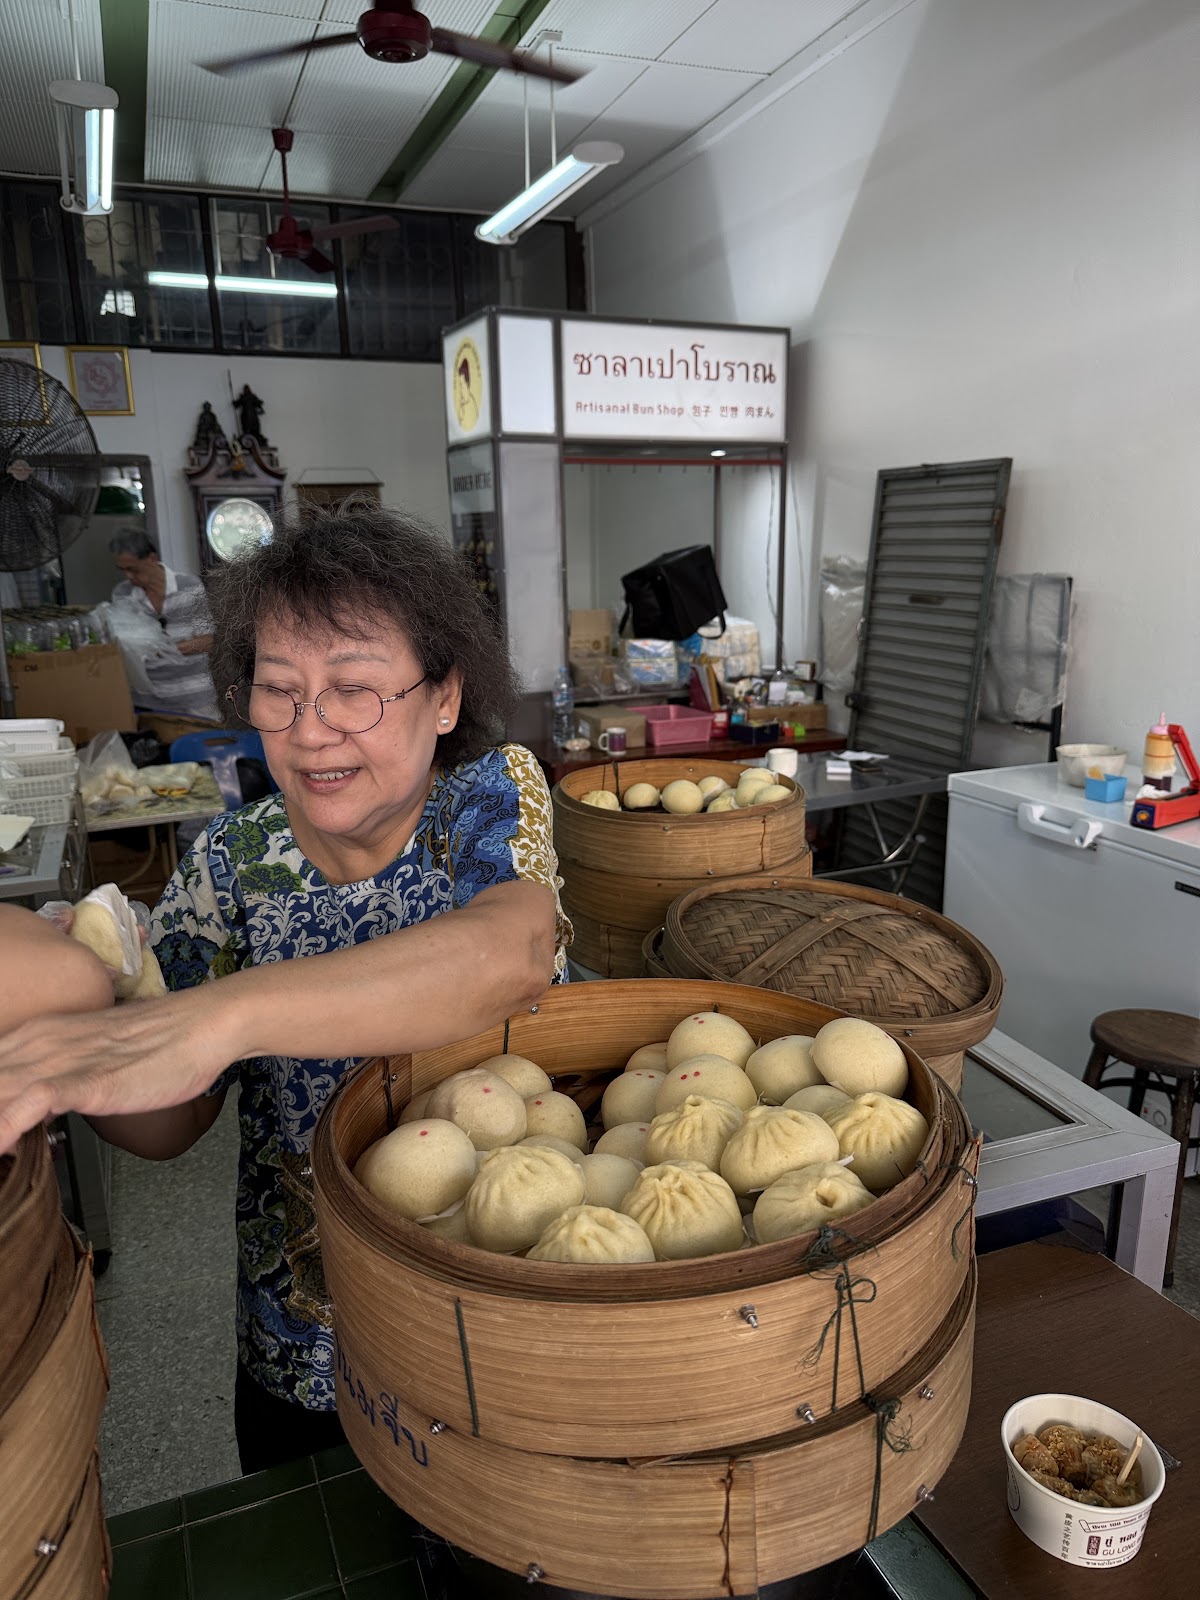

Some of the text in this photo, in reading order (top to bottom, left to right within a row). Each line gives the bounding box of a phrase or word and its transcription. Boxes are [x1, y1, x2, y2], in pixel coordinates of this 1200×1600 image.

[573, 344, 776, 384] ซาลาเปาโบราณ
[575, 402, 630, 415] Artisanal
[633, 403, 654, 415] Bun
[658, 405, 685, 418] Shop
